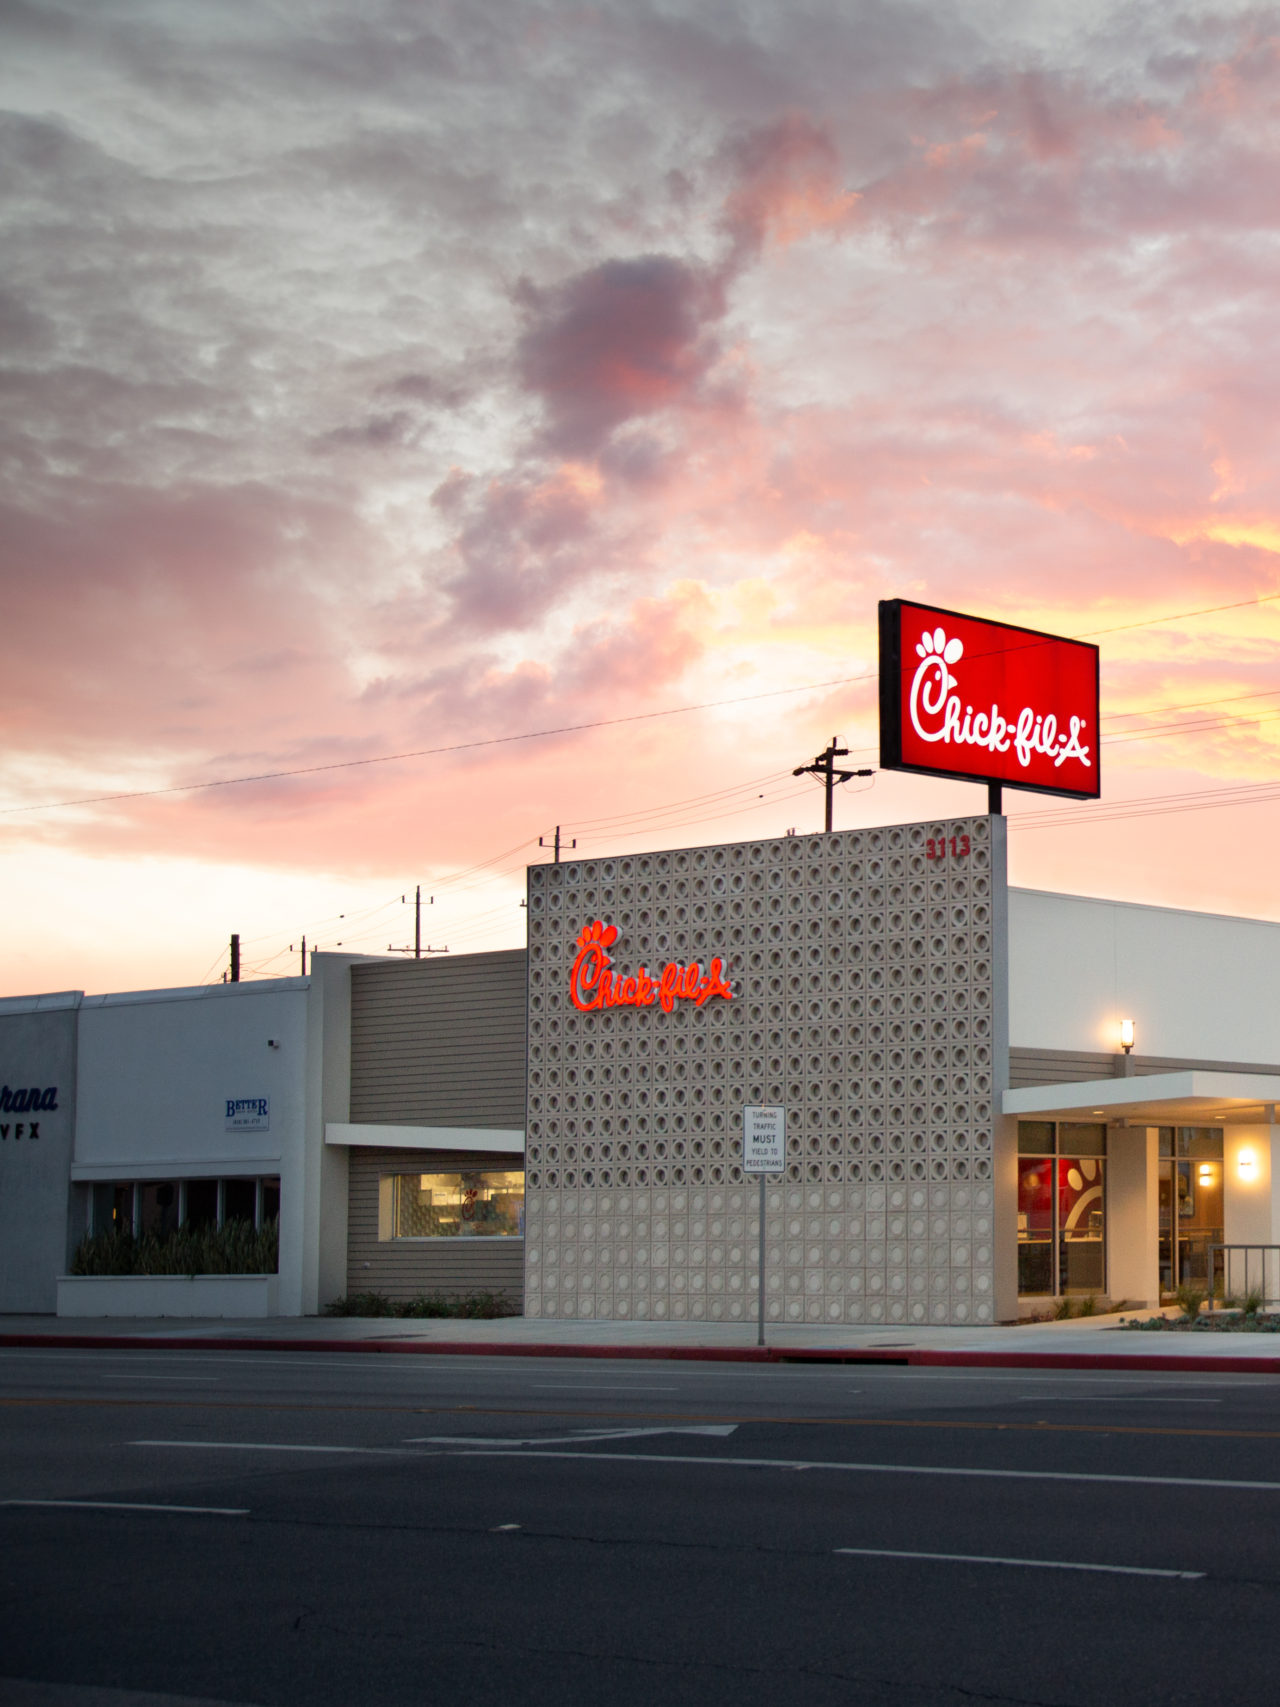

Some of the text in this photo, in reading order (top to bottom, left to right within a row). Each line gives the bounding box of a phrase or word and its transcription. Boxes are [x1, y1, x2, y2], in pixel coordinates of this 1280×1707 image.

[909, 652, 1092, 768] Chick-fil-A
[926, 834, 970, 860] 3113
[570, 940, 733, 1013] Chick-fil-A
[752, 1111, 777, 1119] TURNING
[752, 1134, 776, 1144] MUST
[746, 1159, 782, 1167] PEDESTRIANS
